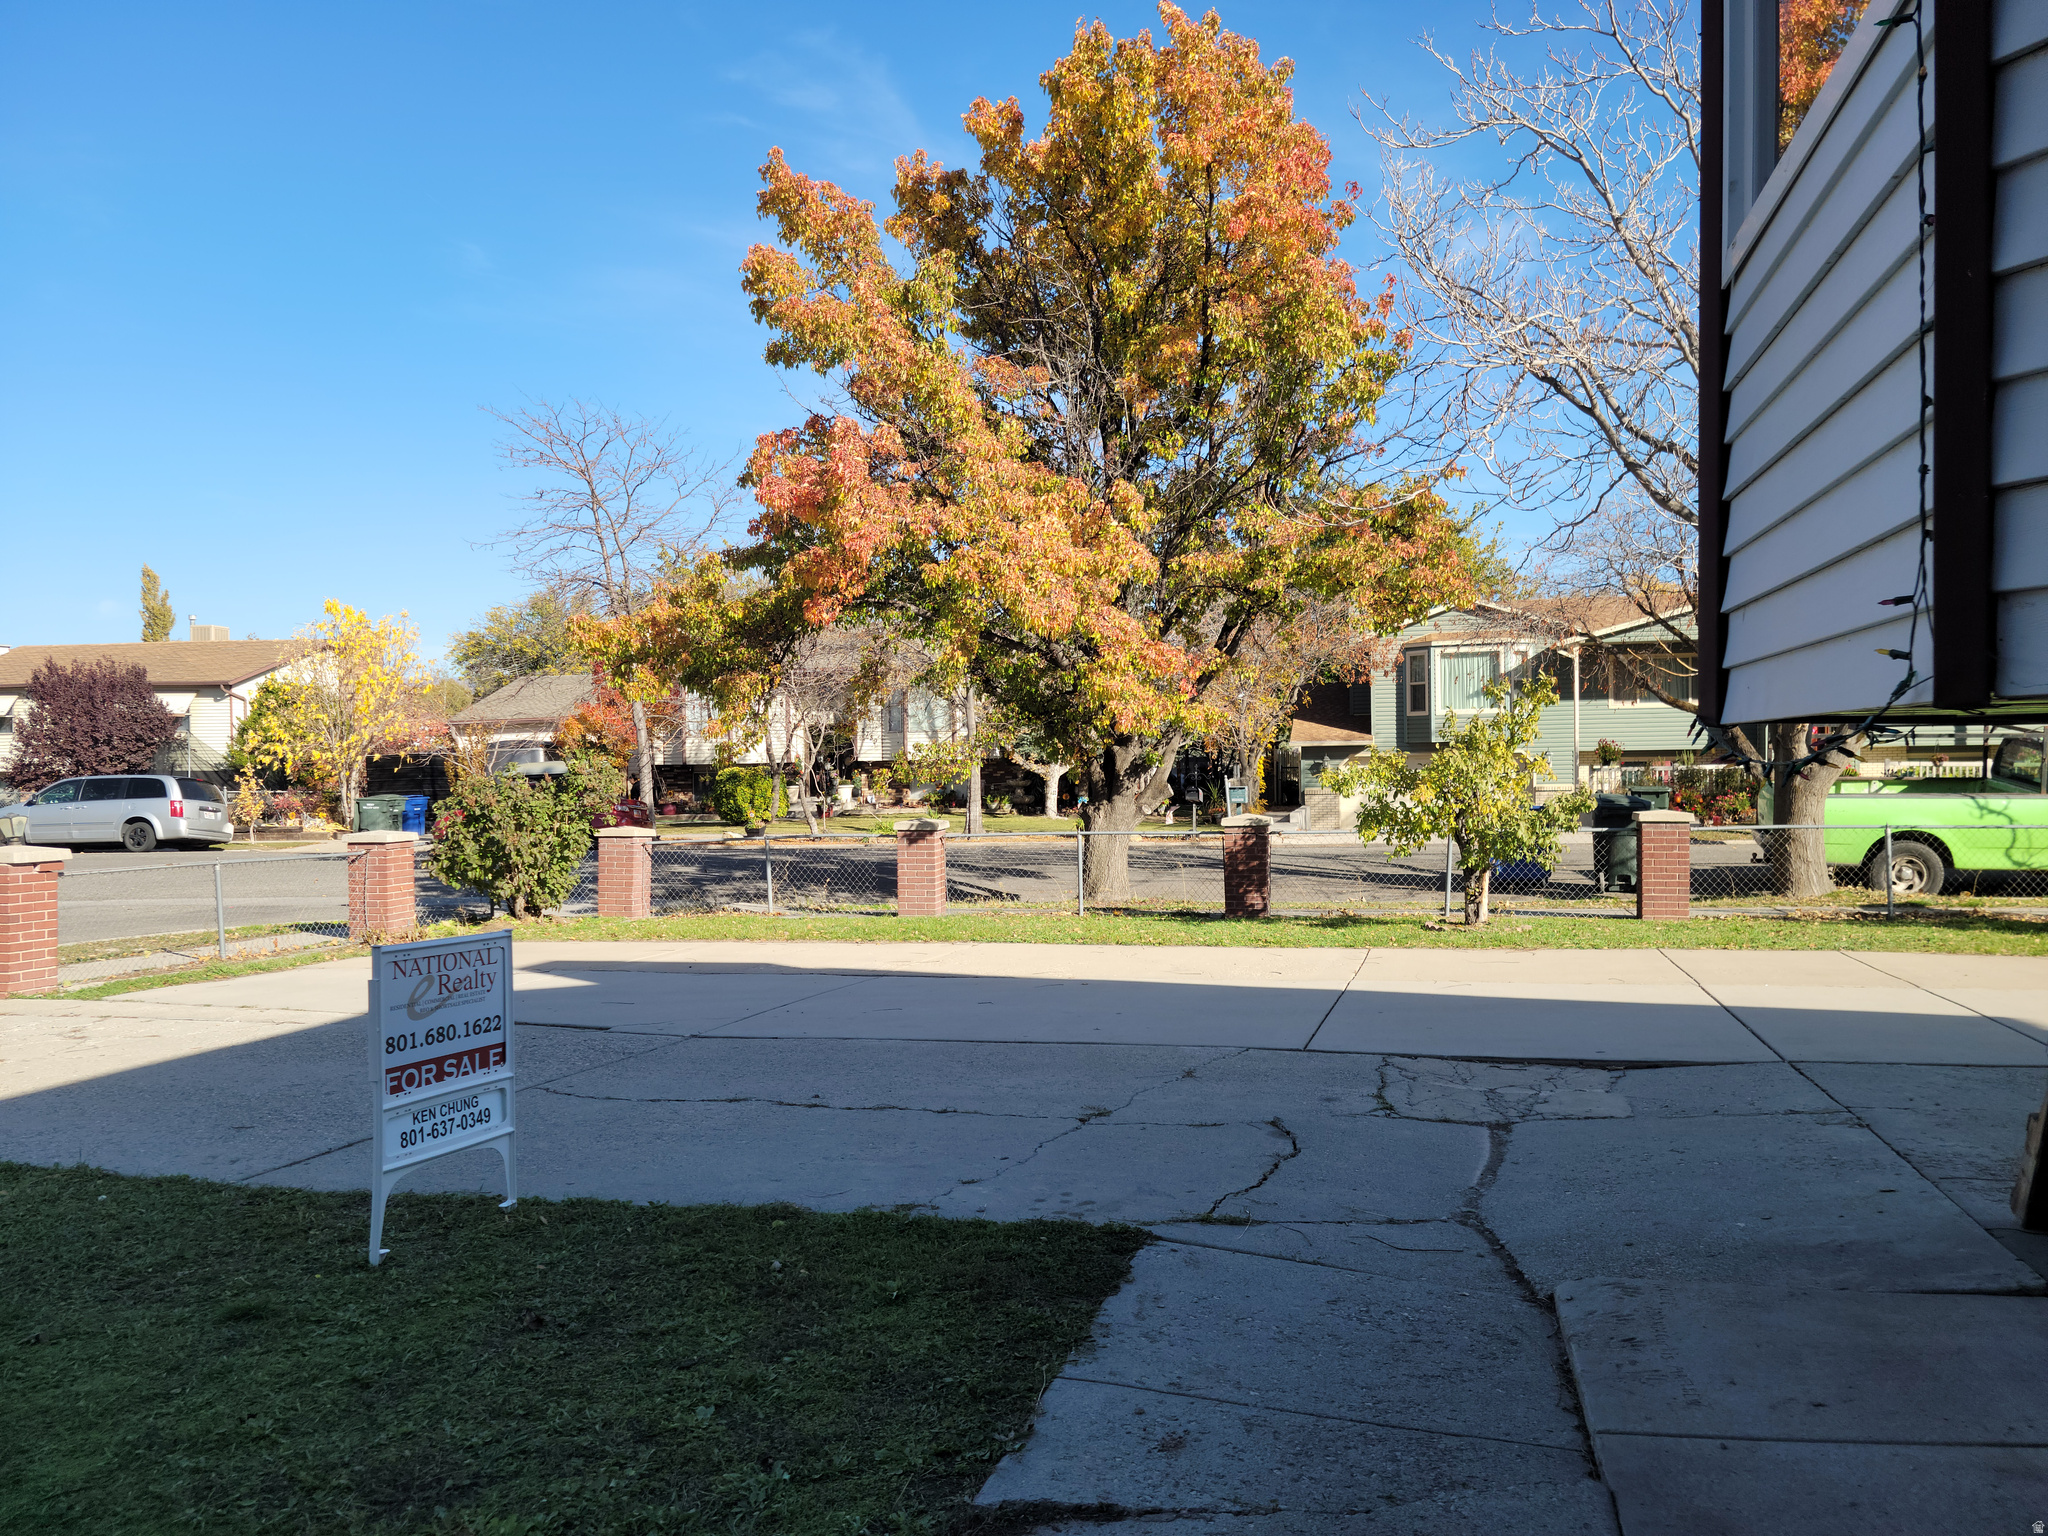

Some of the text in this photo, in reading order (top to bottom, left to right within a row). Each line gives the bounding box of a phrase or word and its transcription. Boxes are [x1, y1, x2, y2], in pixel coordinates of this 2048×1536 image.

[392, 948, 498, 980] NATIONAL
[437, 969, 497, 995] Realty
[389, 1001, 422, 1012] RESIDENTIAL
[470, 989, 486, 998] ESTATE
[460, 996, 486, 1006] SPECIALIST
[385, 1014, 502, 1054] 801.680.1622
[385, 1047, 503, 1096] FOR SALE
[412, 1095, 479, 1125] KEN CHUNG
[400, 1107, 491, 1149] 801-637-0349
